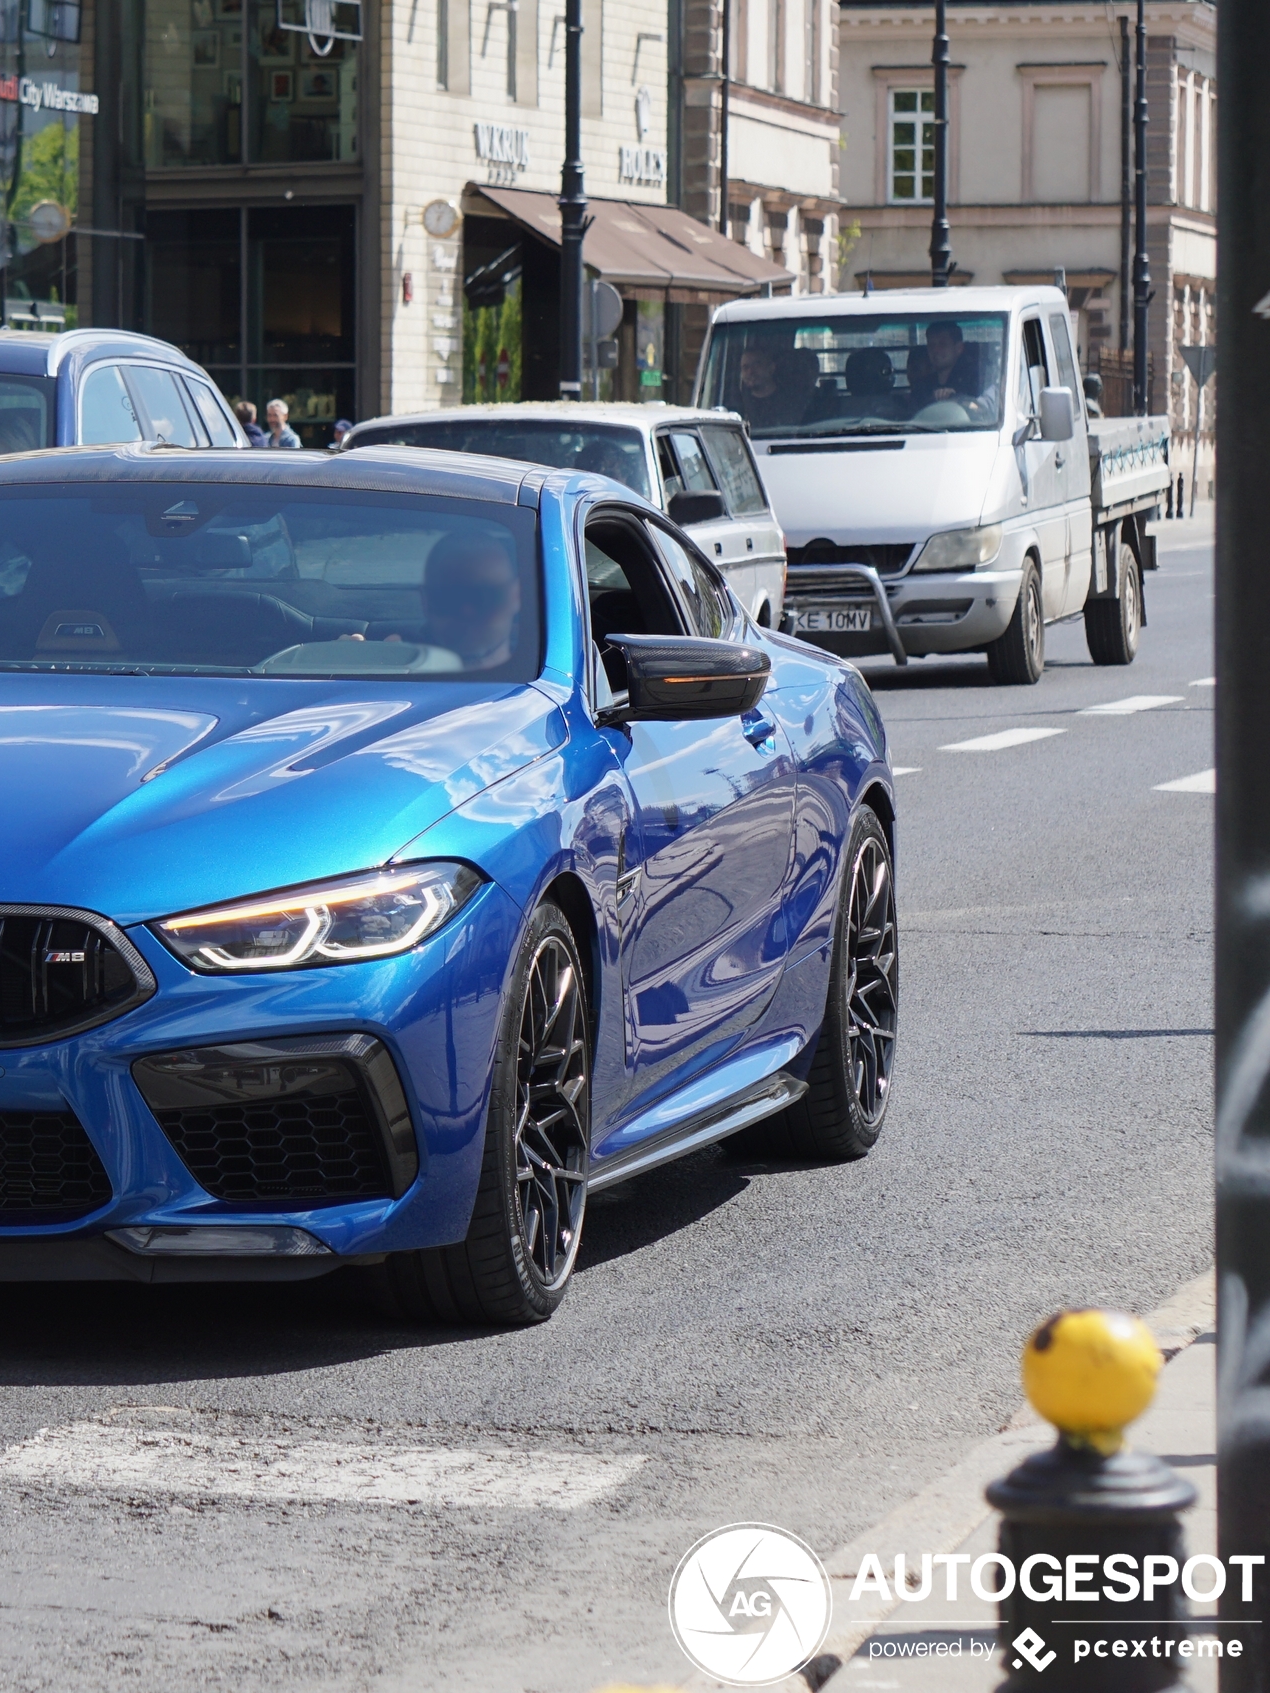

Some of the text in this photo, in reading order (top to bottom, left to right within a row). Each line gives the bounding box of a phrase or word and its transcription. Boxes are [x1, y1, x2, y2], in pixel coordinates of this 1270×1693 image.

[19, 77, 43, 113] City
[42, 82, 99, 115] Warszawa
[619, 146, 665, 182] ROLEX
[826, 611, 868, 629] 10MV
[55, 952, 85, 962] M8
